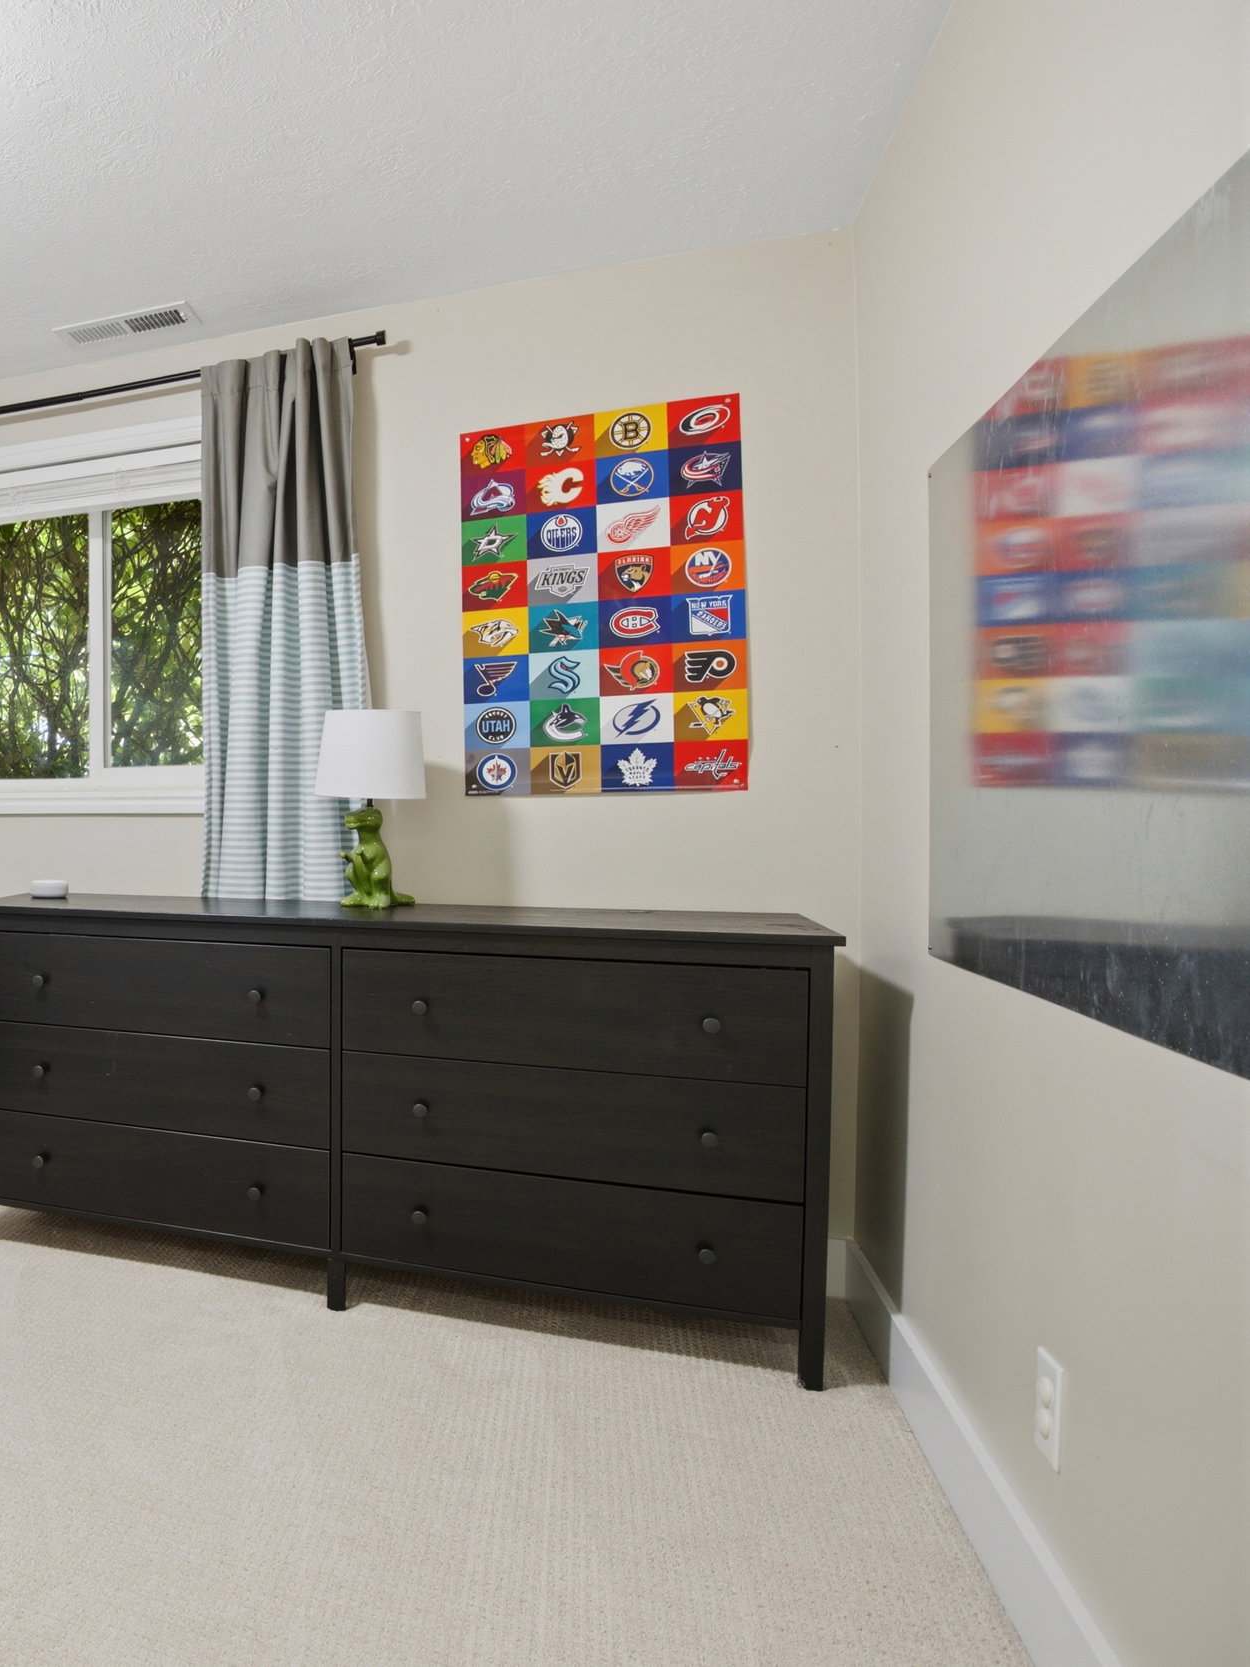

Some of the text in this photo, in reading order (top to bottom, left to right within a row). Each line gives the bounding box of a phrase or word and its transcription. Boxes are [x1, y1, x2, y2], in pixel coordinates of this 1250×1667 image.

[546, 526, 577, 548] OILERS
[541, 570, 586, 586] KINGS
[481, 719, 511, 733] UTAH
